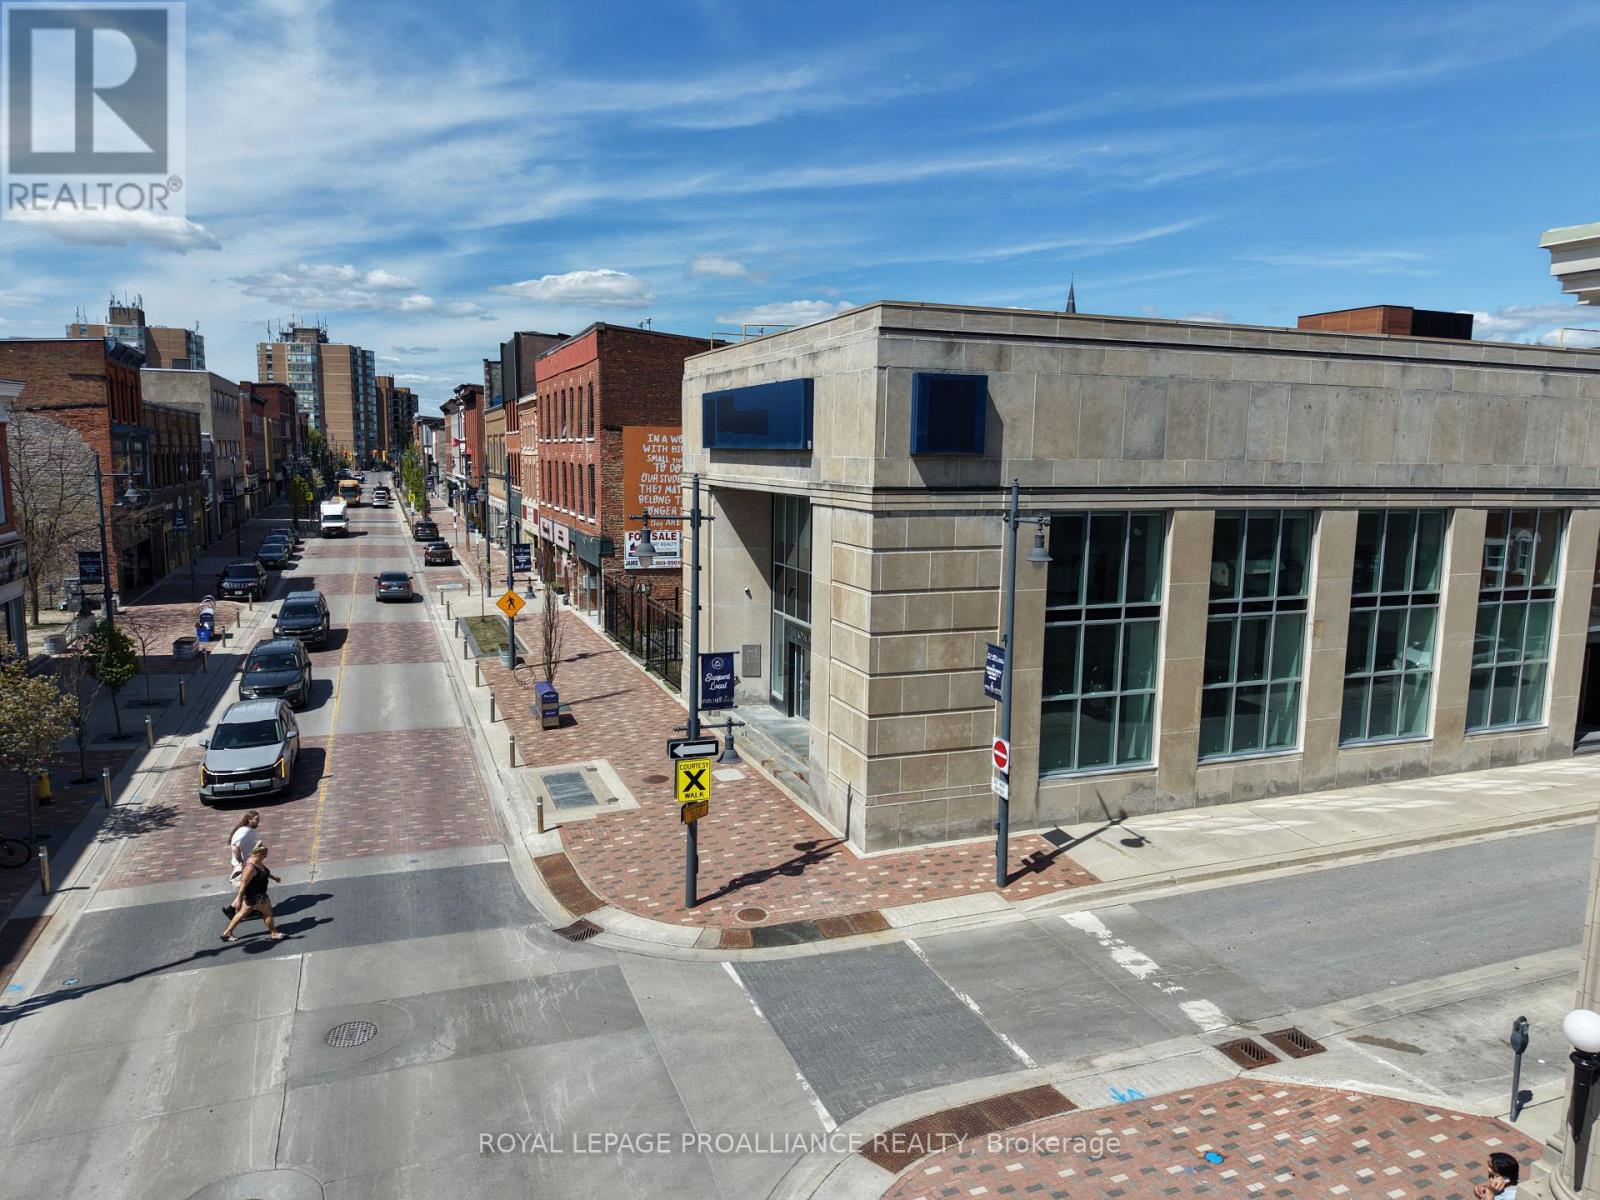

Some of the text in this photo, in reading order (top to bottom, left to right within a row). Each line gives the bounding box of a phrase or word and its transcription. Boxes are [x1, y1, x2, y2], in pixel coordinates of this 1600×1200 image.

[642, 444, 668, 453] WITH
[646, 454, 669, 463] SMALL
[654, 462, 666, 473] TO
[641, 472, 658, 483] OUR
[639, 483, 662, 494] THEY
[638, 494, 671, 505] BELONG
[651, 532, 677, 541] SALE
[704, 672, 731, 685] Support
[709, 681, 728, 691] Local
[679, 762, 709, 771] COURTESY
[684, 791, 704, 799] WALK
